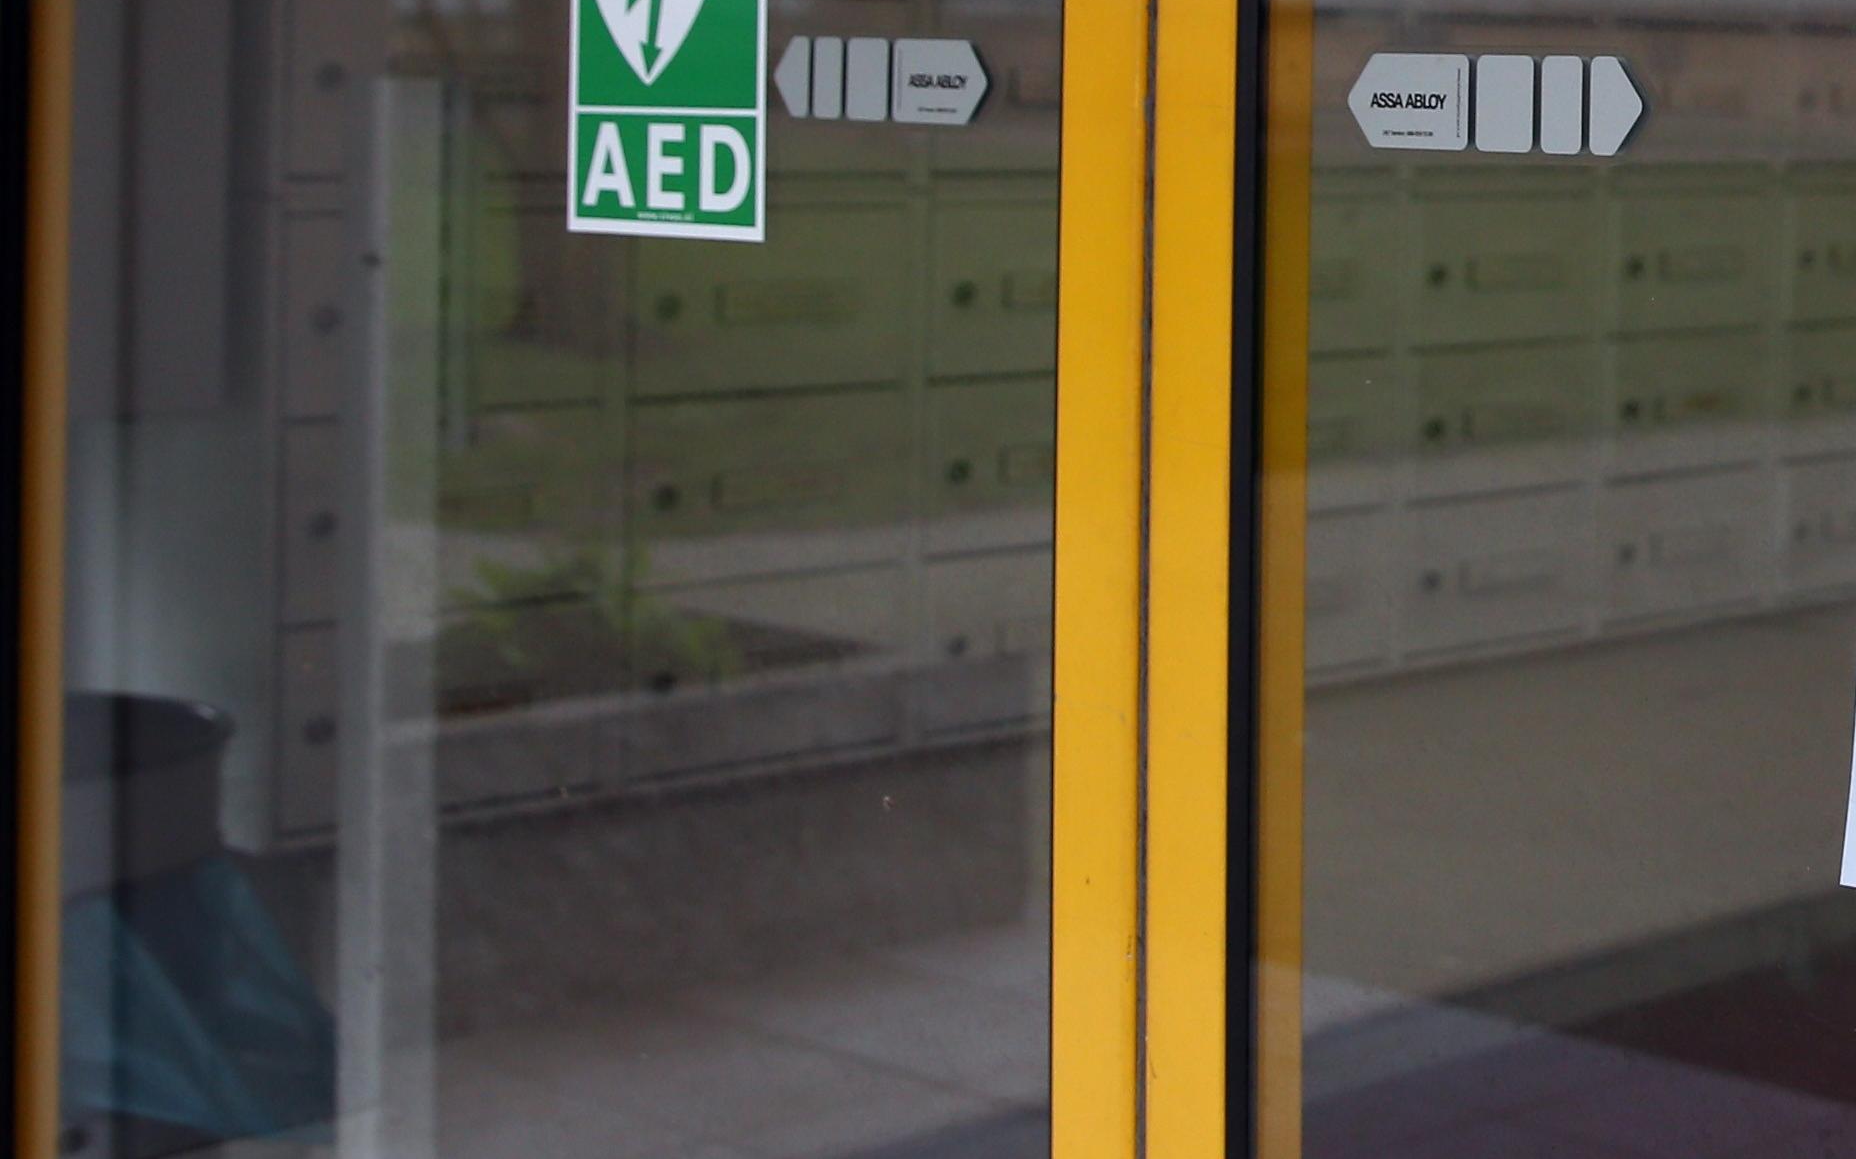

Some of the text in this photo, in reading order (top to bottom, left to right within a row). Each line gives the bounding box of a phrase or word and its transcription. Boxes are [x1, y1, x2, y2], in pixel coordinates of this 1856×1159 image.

[1371, 92, 1447, 110] ASSA ABLOY
[582, 121, 751, 213] AED
